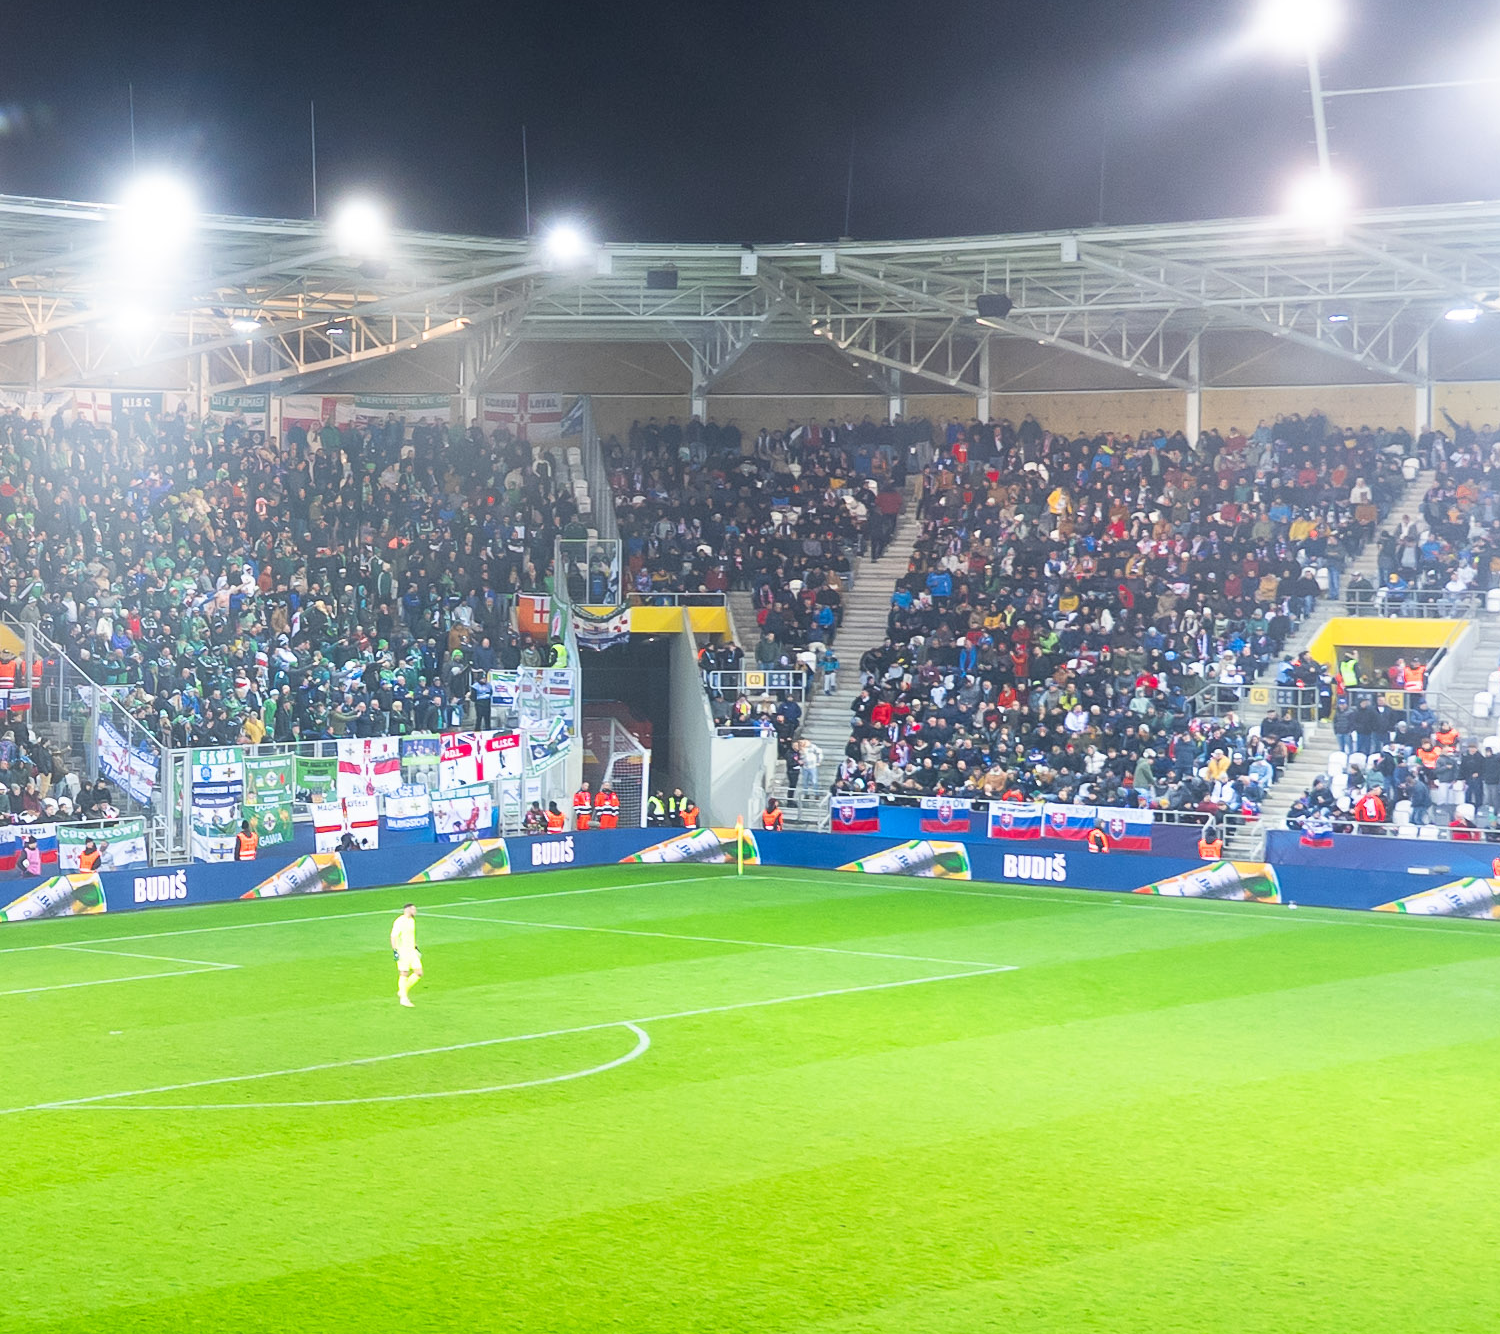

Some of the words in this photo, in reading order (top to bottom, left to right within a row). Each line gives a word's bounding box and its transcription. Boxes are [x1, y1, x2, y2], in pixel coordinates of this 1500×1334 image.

[259, 833, 283, 846] GAWA
[531, 836, 575, 866] BUDIŠ
[1003, 853, 1066, 881] BUDIŠ
[134, 869, 187, 903] BUDIŠ
